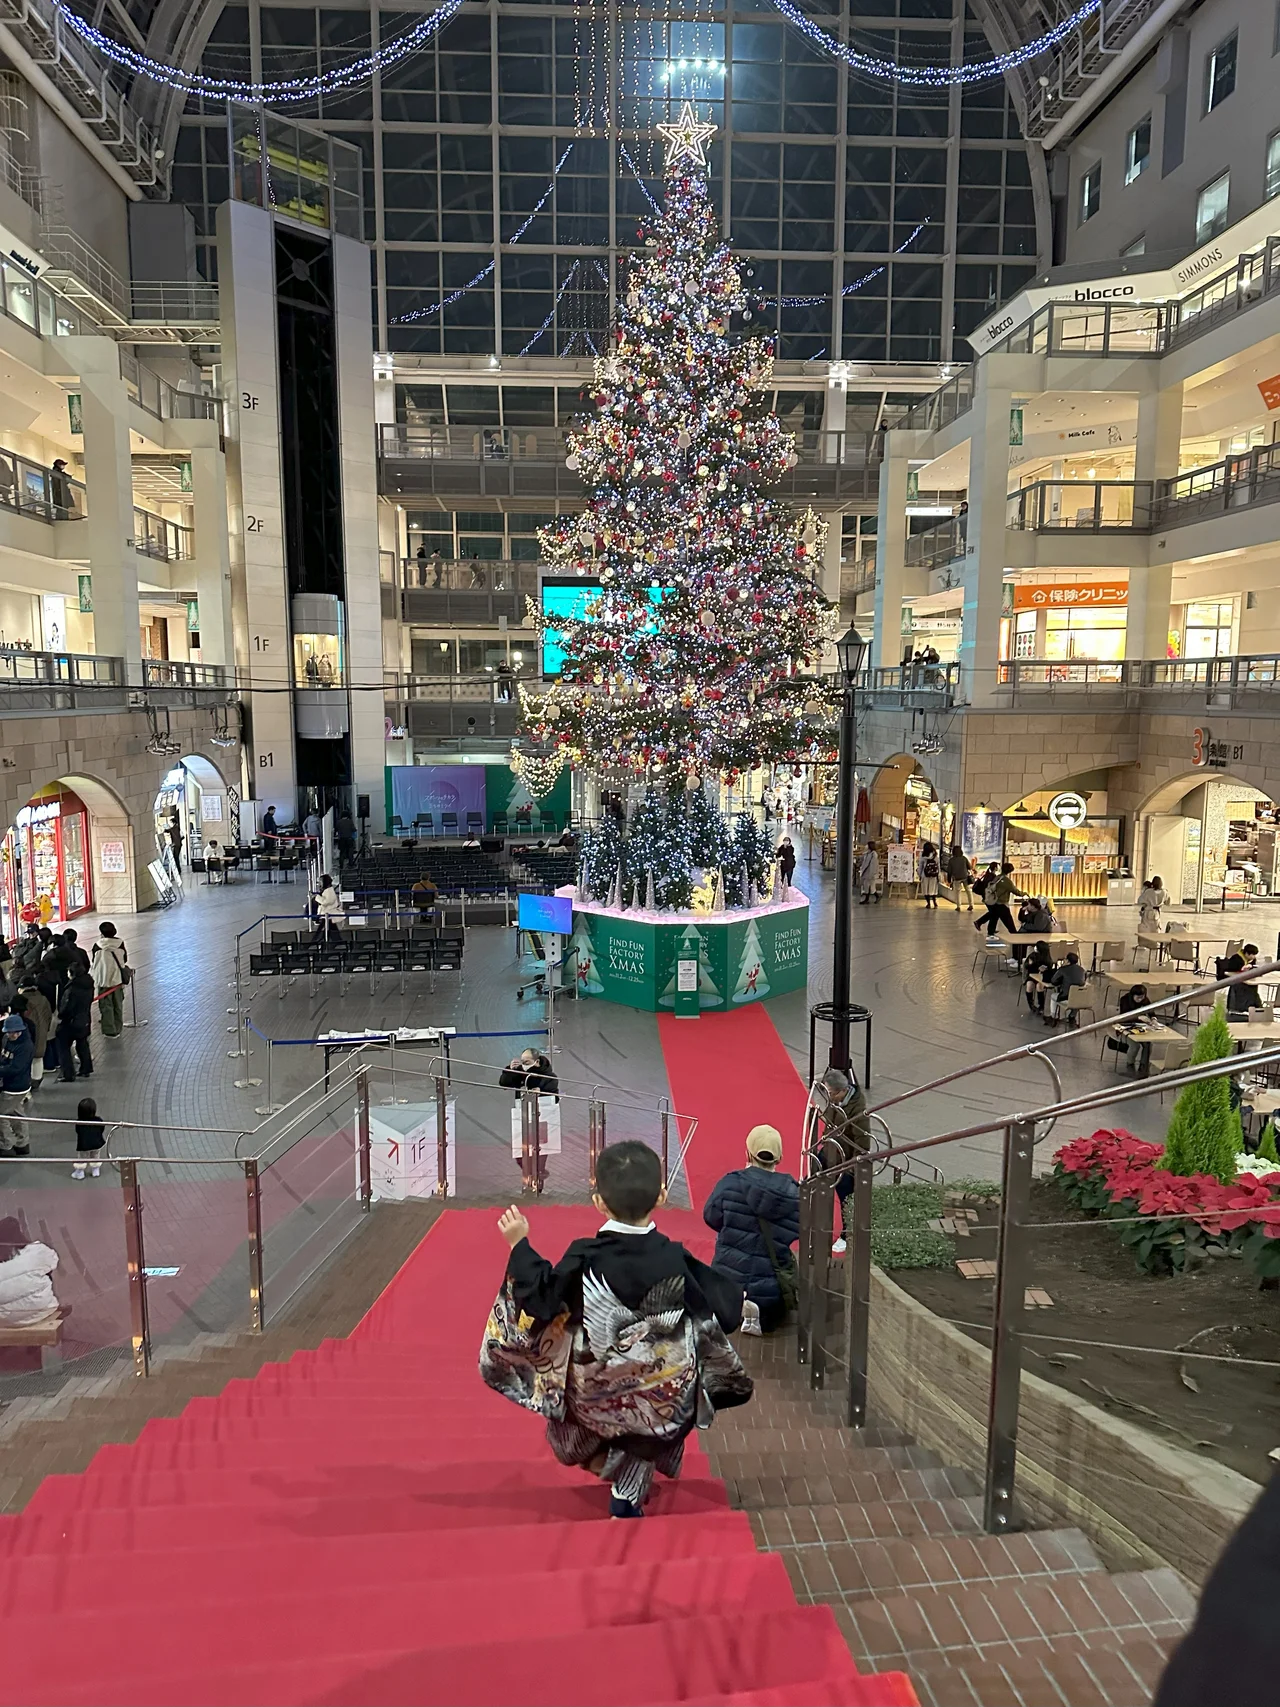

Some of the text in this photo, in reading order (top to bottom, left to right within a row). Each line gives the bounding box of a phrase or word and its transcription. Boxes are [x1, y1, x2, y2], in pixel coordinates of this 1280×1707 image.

[1177, 248, 1223, 283] SIMMONS
[1074, 286, 1134, 301] blocco
[987, 316, 1014, 340] blocco
[242, 392, 259, 410] 3F
[247, 515, 264, 533] 2F
[253, 635, 270, 652] 1F
[259, 752, 274, 768] B1
[1233, 744, 1244, 760] B1
[774, 928, 802, 941] FIND FUN
[609, 936, 644, 951] FIND FUN
[774, 937, 802, 950] FACTORY
[609, 946, 645, 961] FACTORY
[774, 946, 801, 964] XMAS
[609, 954, 645, 975] XMAS
